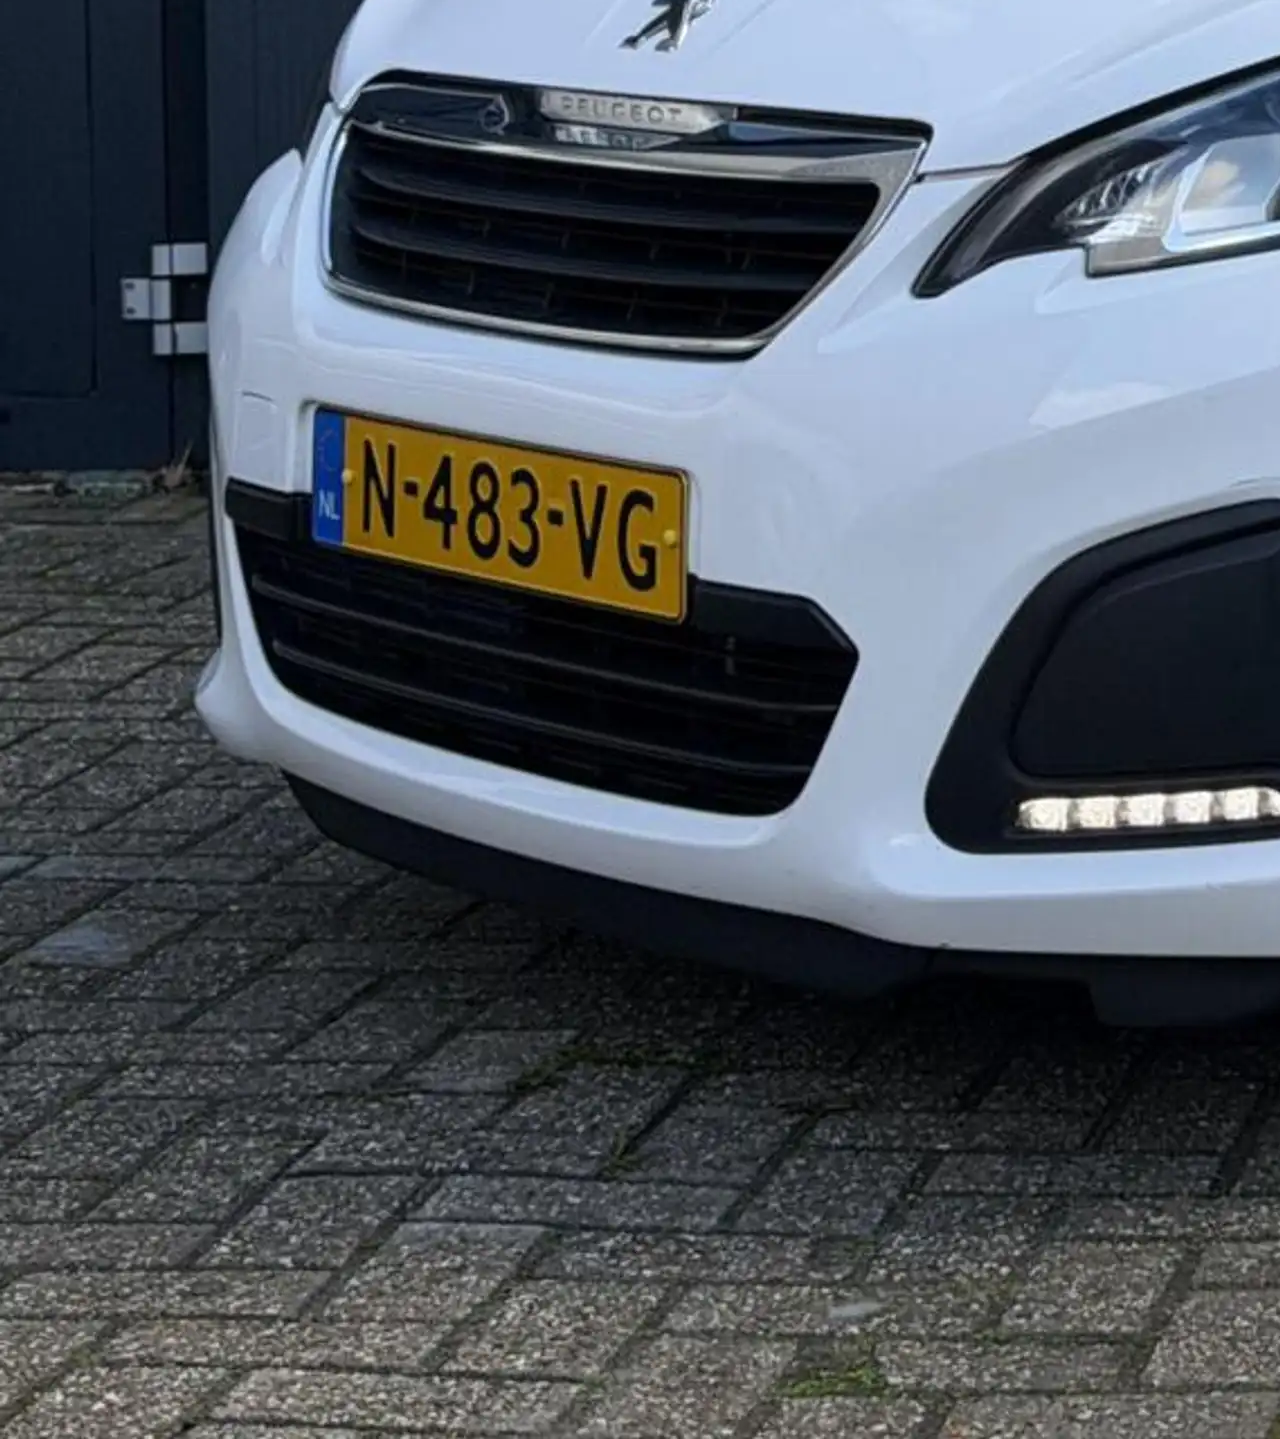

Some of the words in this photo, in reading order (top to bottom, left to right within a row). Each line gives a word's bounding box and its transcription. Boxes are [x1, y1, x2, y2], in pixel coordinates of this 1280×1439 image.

[560, 95, 682, 123] PEUGEOT
[318, 489, 341, 521] NL
[361, 438, 659, 591] N-483-VG
